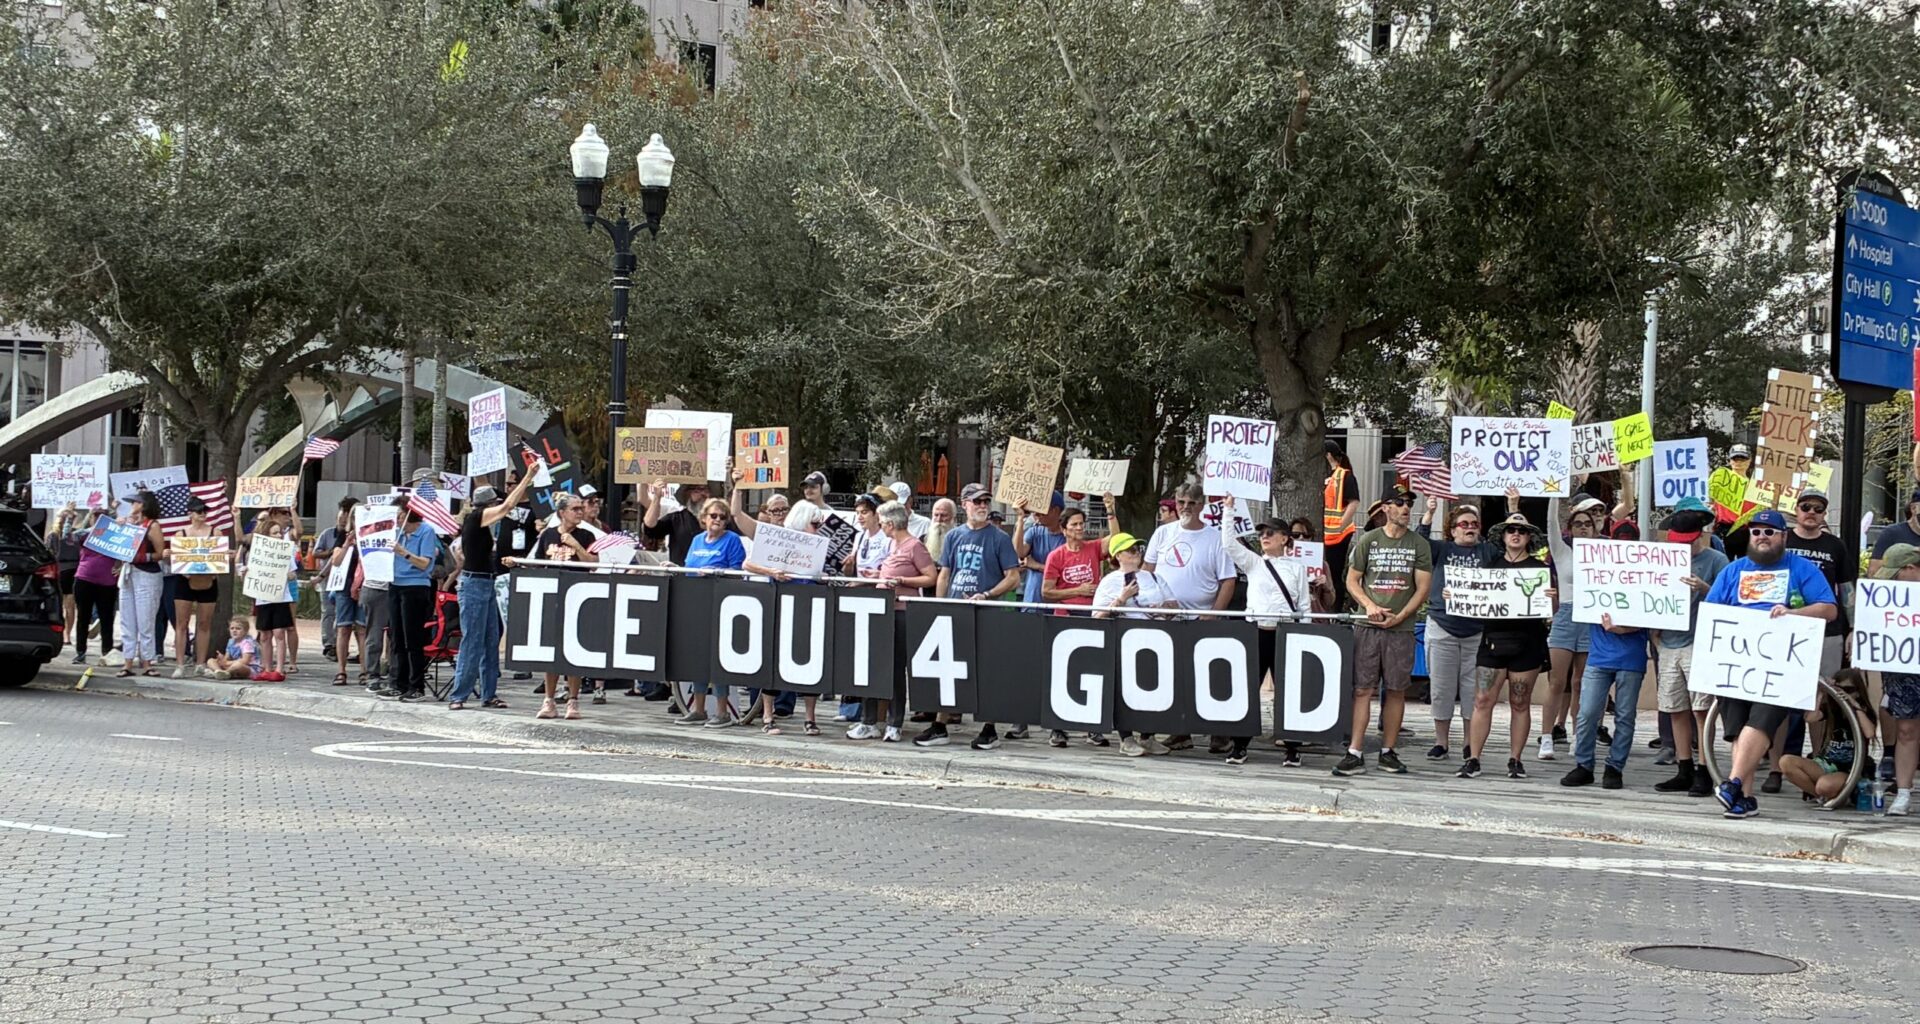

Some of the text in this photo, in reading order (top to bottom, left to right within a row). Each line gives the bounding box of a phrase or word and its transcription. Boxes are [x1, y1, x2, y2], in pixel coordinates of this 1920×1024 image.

[1862, 200, 1887, 226] SODO
[1859, 239, 1893, 266] Hospital
[1845, 273, 1863, 299] City
[1863, 277, 1880, 299] Hall
[1844, 311, 1854, 332] Dr
[1855, 314, 1884, 342] Phillips
[1885, 322, 1898, 341] Ctr
[472, 393, 501, 416] KEITH
[1766, 383, 1822, 414] LITTLE
[1211, 421, 1275, 447] PROTECT
[1503, 420, 1518, 430] the
[1572, 425, 1602, 442] HEN
[1760, 411, 1816, 448] DICK
[621, 435, 698, 454] CHINGA
[741, 430, 784, 448] CHINGA
[1460, 428, 1551, 449] PROTECT
[1585, 438, 1614, 454] CAME
[754, 448, 769, 464] LA
[1011, 441, 1032, 457] ICE
[1228, 447, 1252, 460] the
[1549, 449, 1562, 459] NO
[618, 459, 642, 476] LA
[1014, 456, 1025, 468] SS
[1494, 450, 1540, 472] OUR
[1571, 452, 1616, 470] OR ME
[1666, 448, 1696, 471] ICE
[1758, 446, 1808, 473] TATER
[249, 476, 273, 486] LIKE
[283, 476, 296, 485] MY
[743, 466, 782, 484] MIGRA
[1205, 460, 1273, 486] CONSTITUTION
[1462, 470, 1538, 490] Constitution
[241, 484, 297, 493] RIGHTS WITH
[1662, 477, 1706, 502] OUT!
[240, 492, 294, 506] NO ICE
[369, 495, 387, 504] STOP
[107, 521, 138, 538] WE ARE
[759, 525, 824, 549] DEMOCRACY
[88, 535, 135, 558] IMMIGRANTS
[254, 535, 291, 551] TRUMP
[254, 548, 262, 556] IS
[264, 550, 276, 559] THE
[957, 551, 983, 571] ICE
[1576, 543, 1688, 567] IMMIGRANTS
[1445, 566, 1510, 580] ICE IS FOR
[1581, 568, 1670, 587] THEY GET THE
[246, 577, 283, 597] TRUMP
[1446, 579, 1508, 591] MARGARITAS
[1453, 592, 1469, 601] NOT
[1583, 589, 1686, 616] JOB DONE
[1860, 582, 1910, 608] YOU
[1447, 600, 1510, 617] AMERICANS
[1884, 611, 1920, 629] FOR
[511, 576, 1343, 732] ICE OUT 4 GOOD
[1856, 630, 1920, 666] PEDO
[1715, 662, 1784, 699] ICE
